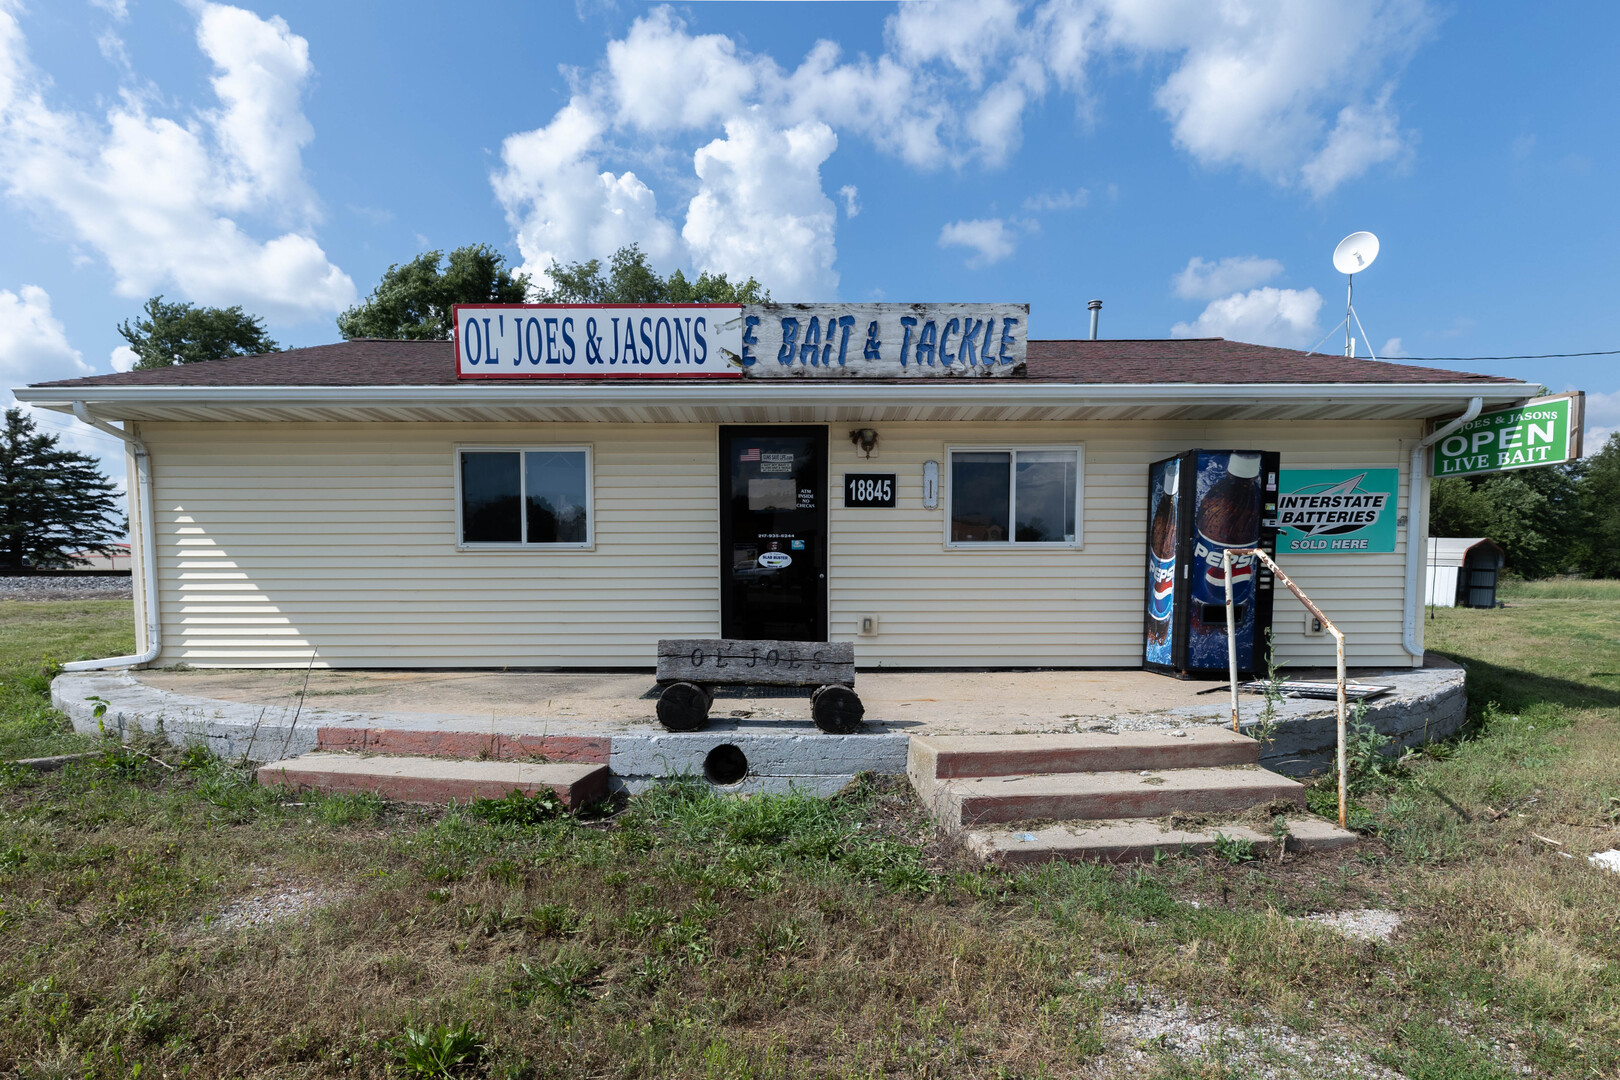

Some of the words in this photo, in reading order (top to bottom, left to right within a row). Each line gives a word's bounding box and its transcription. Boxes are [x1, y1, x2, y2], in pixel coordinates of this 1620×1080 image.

[465, 315, 504, 366] OL'
[513, 316, 576, 367] JOES
[585, 316, 604, 366] &
[609, 316, 708, 366] JASONS
[777, 314, 856, 368] BAIT
[864, 320, 882, 361] &
[900, 315, 1019, 368] TACKLE
[1494, 415, 1506, 425] &
[1508, 411, 1558, 425] JASONS
[1441, 420, 1555, 457] OPEN
[1442, 454, 1490, 473] LIVE
[1497, 445, 1552, 466] BAIT
[849, 479, 891, 501] 18845
[1279, 495, 1384, 509] INTERSTATE
[1281, 510, 1376, 524] BATTERIES
[1290, 539, 1328, 550] SOLD
[1331, 539, 1369, 550] HERE
